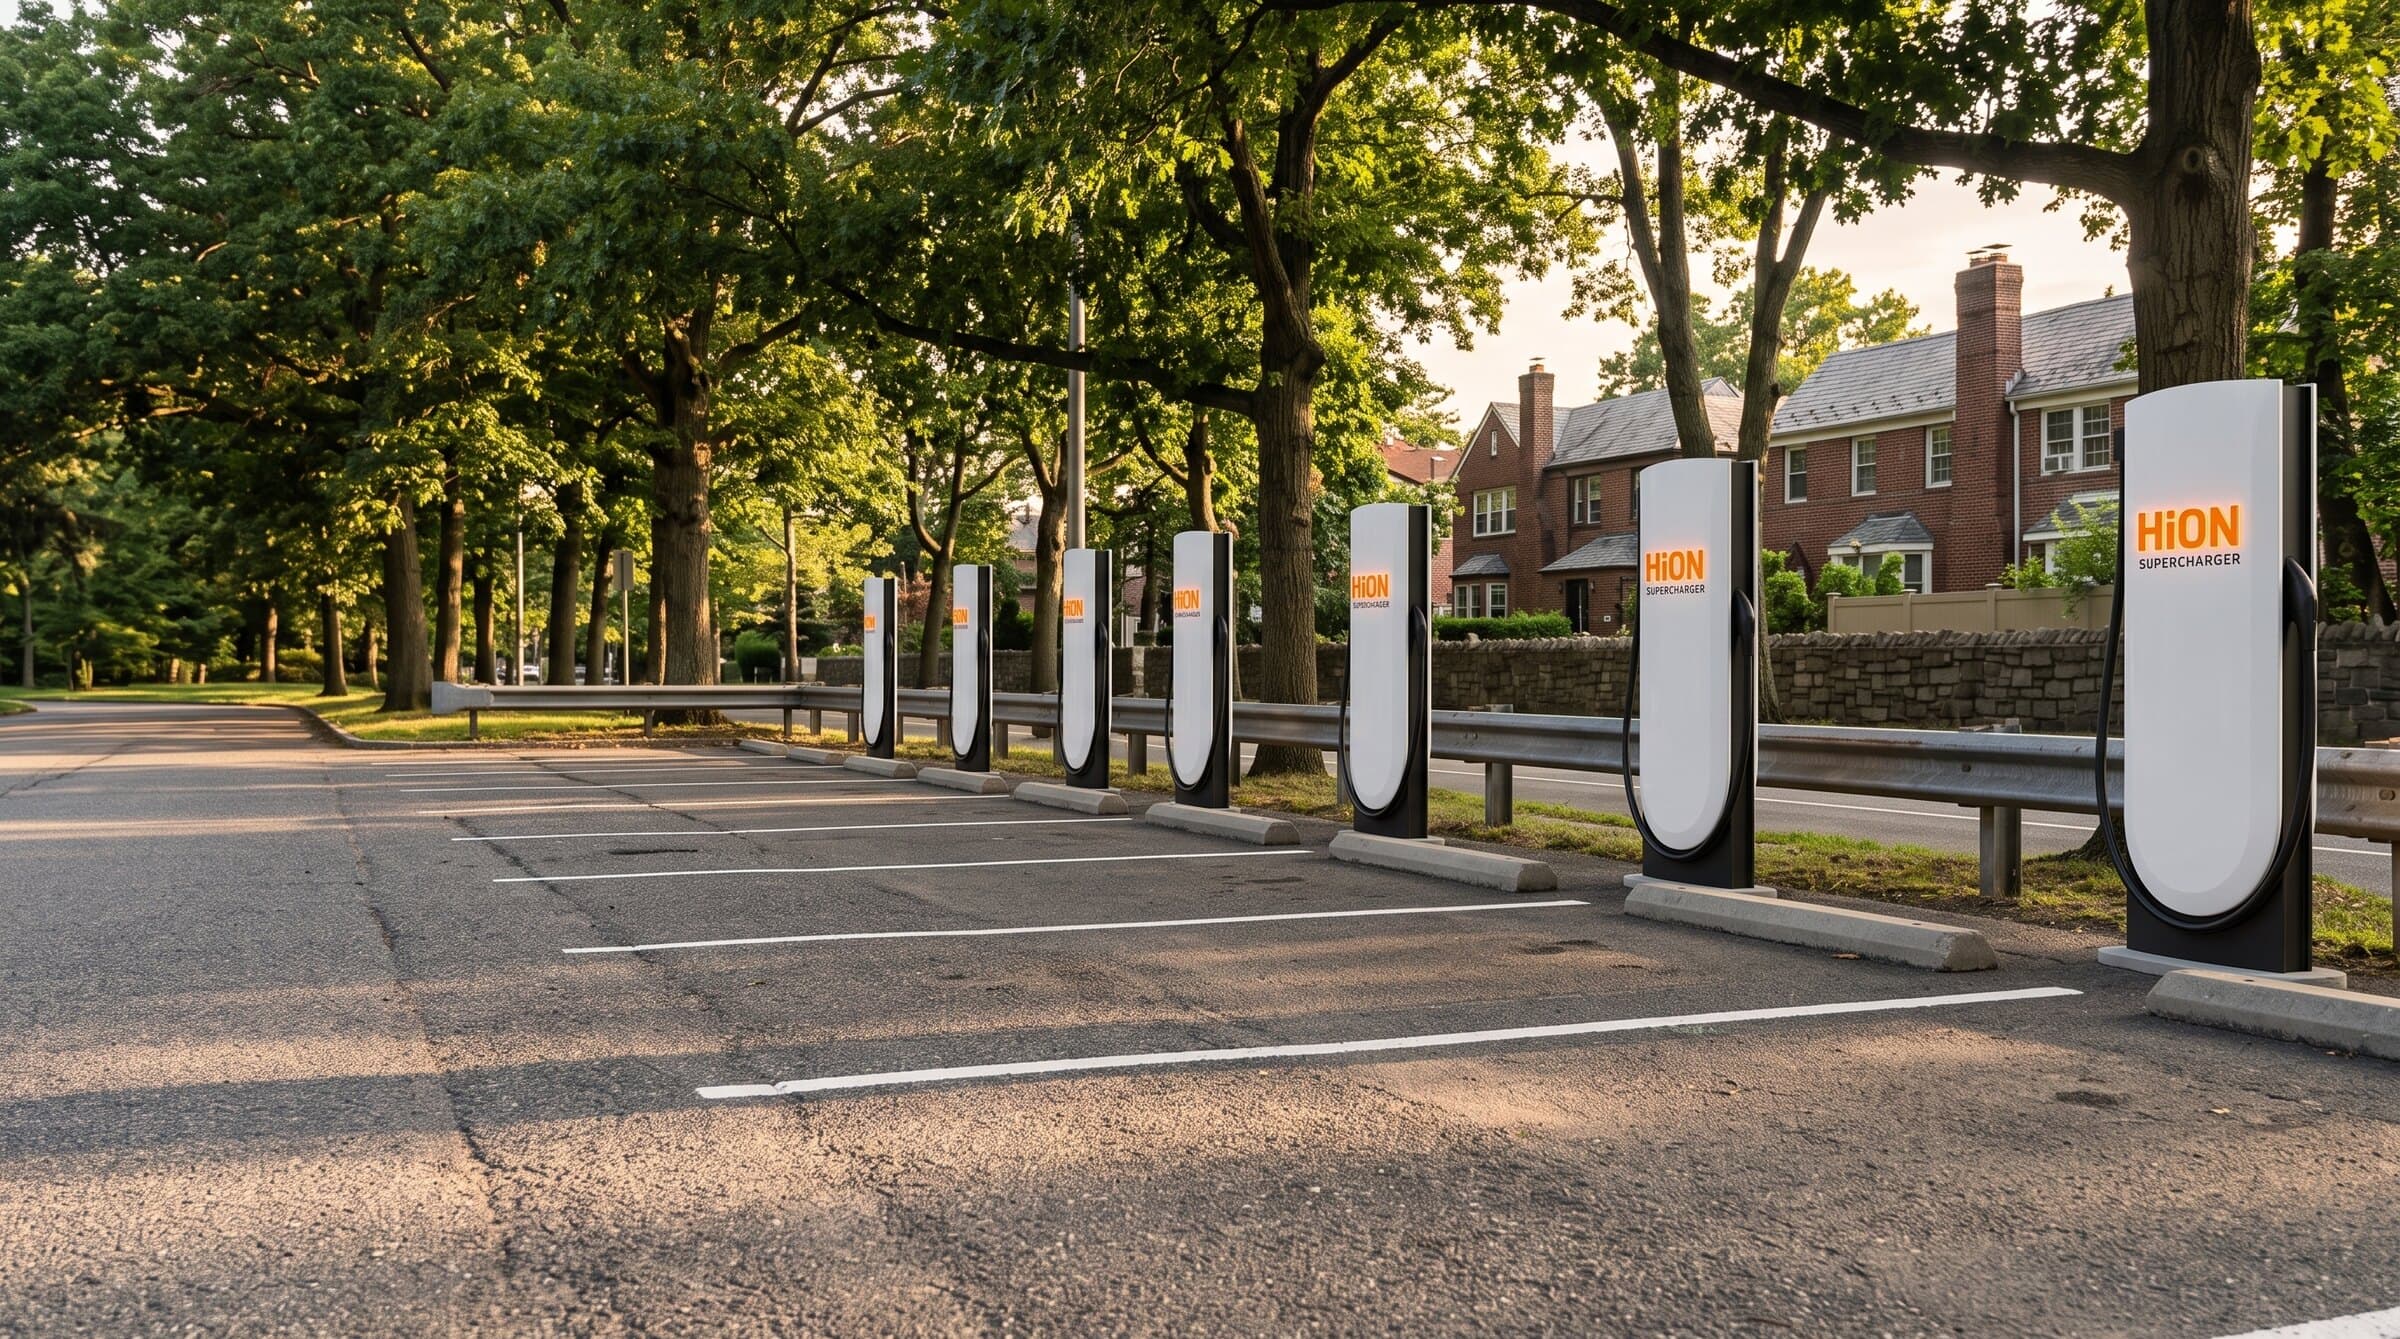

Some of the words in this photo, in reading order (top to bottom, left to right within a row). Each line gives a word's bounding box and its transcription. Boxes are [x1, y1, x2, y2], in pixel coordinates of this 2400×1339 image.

[2138, 505, 2239, 552] HiON
[1646, 550, 1704, 582] HiON
[2139, 553, 2241, 570] SUPERCHARGER
[1352, 574, 1388, 599] HiON
[1646, 584, 1705, 596] SUPERCHARGER
